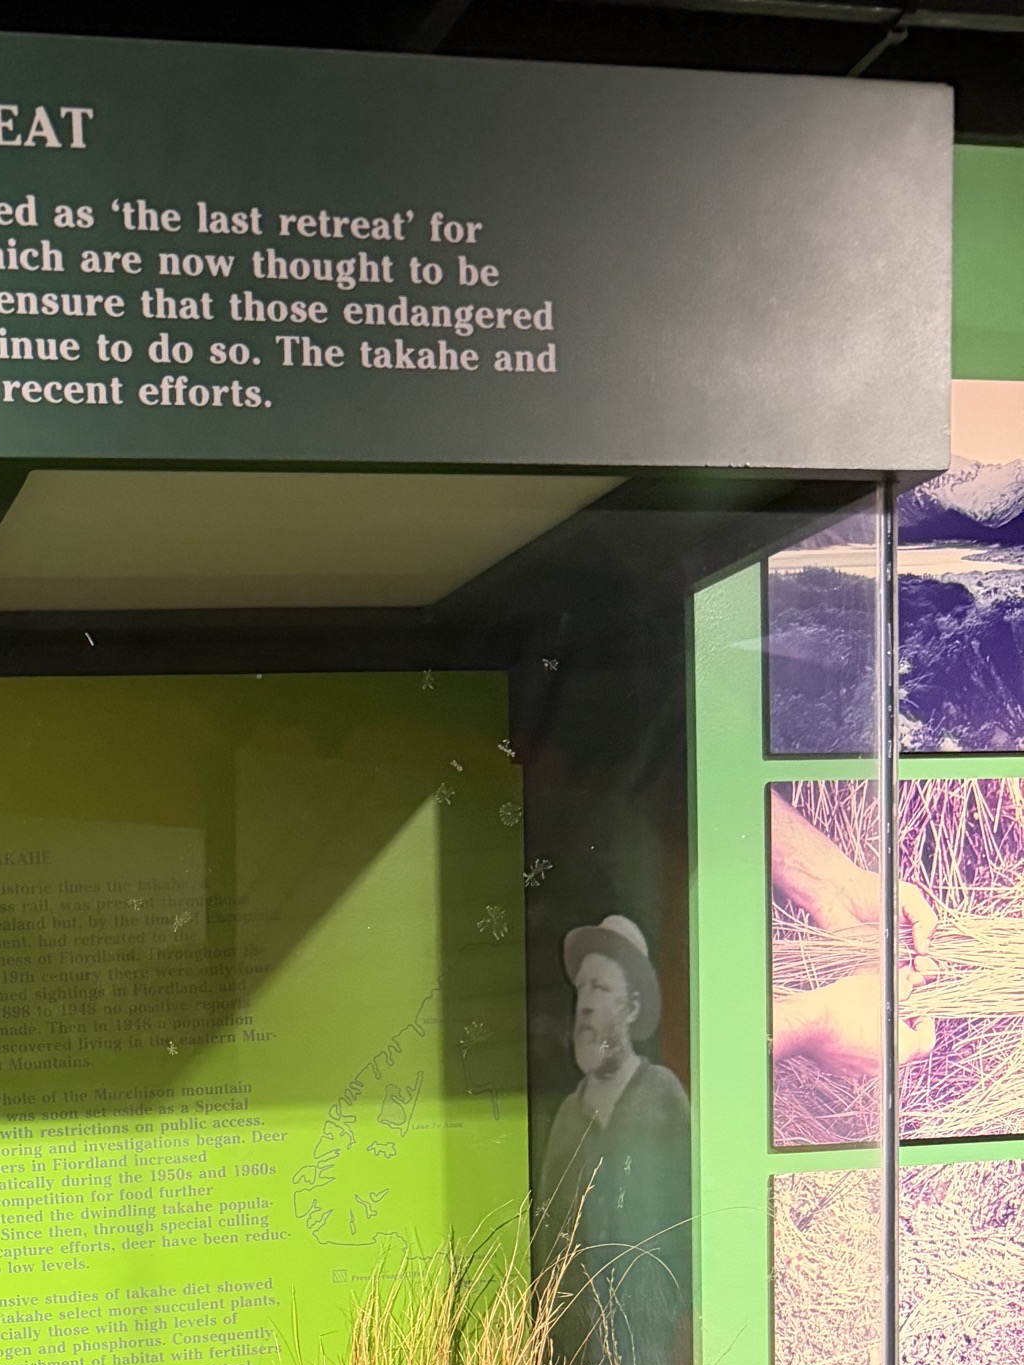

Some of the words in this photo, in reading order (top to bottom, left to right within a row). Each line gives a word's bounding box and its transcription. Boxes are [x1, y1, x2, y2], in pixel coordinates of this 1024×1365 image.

[53, 204, 94, 228] as
[196, 200, 262, 235] last
[429, 211, 482, 243] for
[80, 249, 141, 274] are
[158, 252, 234, 277] now
[251, 247, 394, 290] thought
[409, 256, 443, 285] to
[457, 254, 499, 286] be
[140, 287, 214, 320] that
[228, 290, 327, 323] those
[343, 295, 553, 336] endangered
[96, 333, 132, 362] to
[148, 332, 193, 363] do
[209, 342, 260, 365] so.
[275, 335, 344, 367] The
[359, 338, 479, 371] takahe
[493, 342, 556, 372] and
[2, 376, 123, 404] recent
[138, 374, 271, 408] efforts.
[9, 1054, 94, 1071] Mountains.
[0, 1126, 33, 1139] with
[39, 1122, 129, 1138] restrictions
[134, 1123, 153, 1133] on
[160, 1117, 207, 1134] public
[212, 1117, 264, 1128] access.
[60, 1172, 112, 1188] during
[118, 1170, 143, 1184] the
[150, 1167, 192, 1182] 1950s
[198, 1165, 226, 1179] and
[234, 1162, 276, 1177] 1960s
[7, 1261, 34, 1273] low
[41, 1257, 89, 1271] levels.
